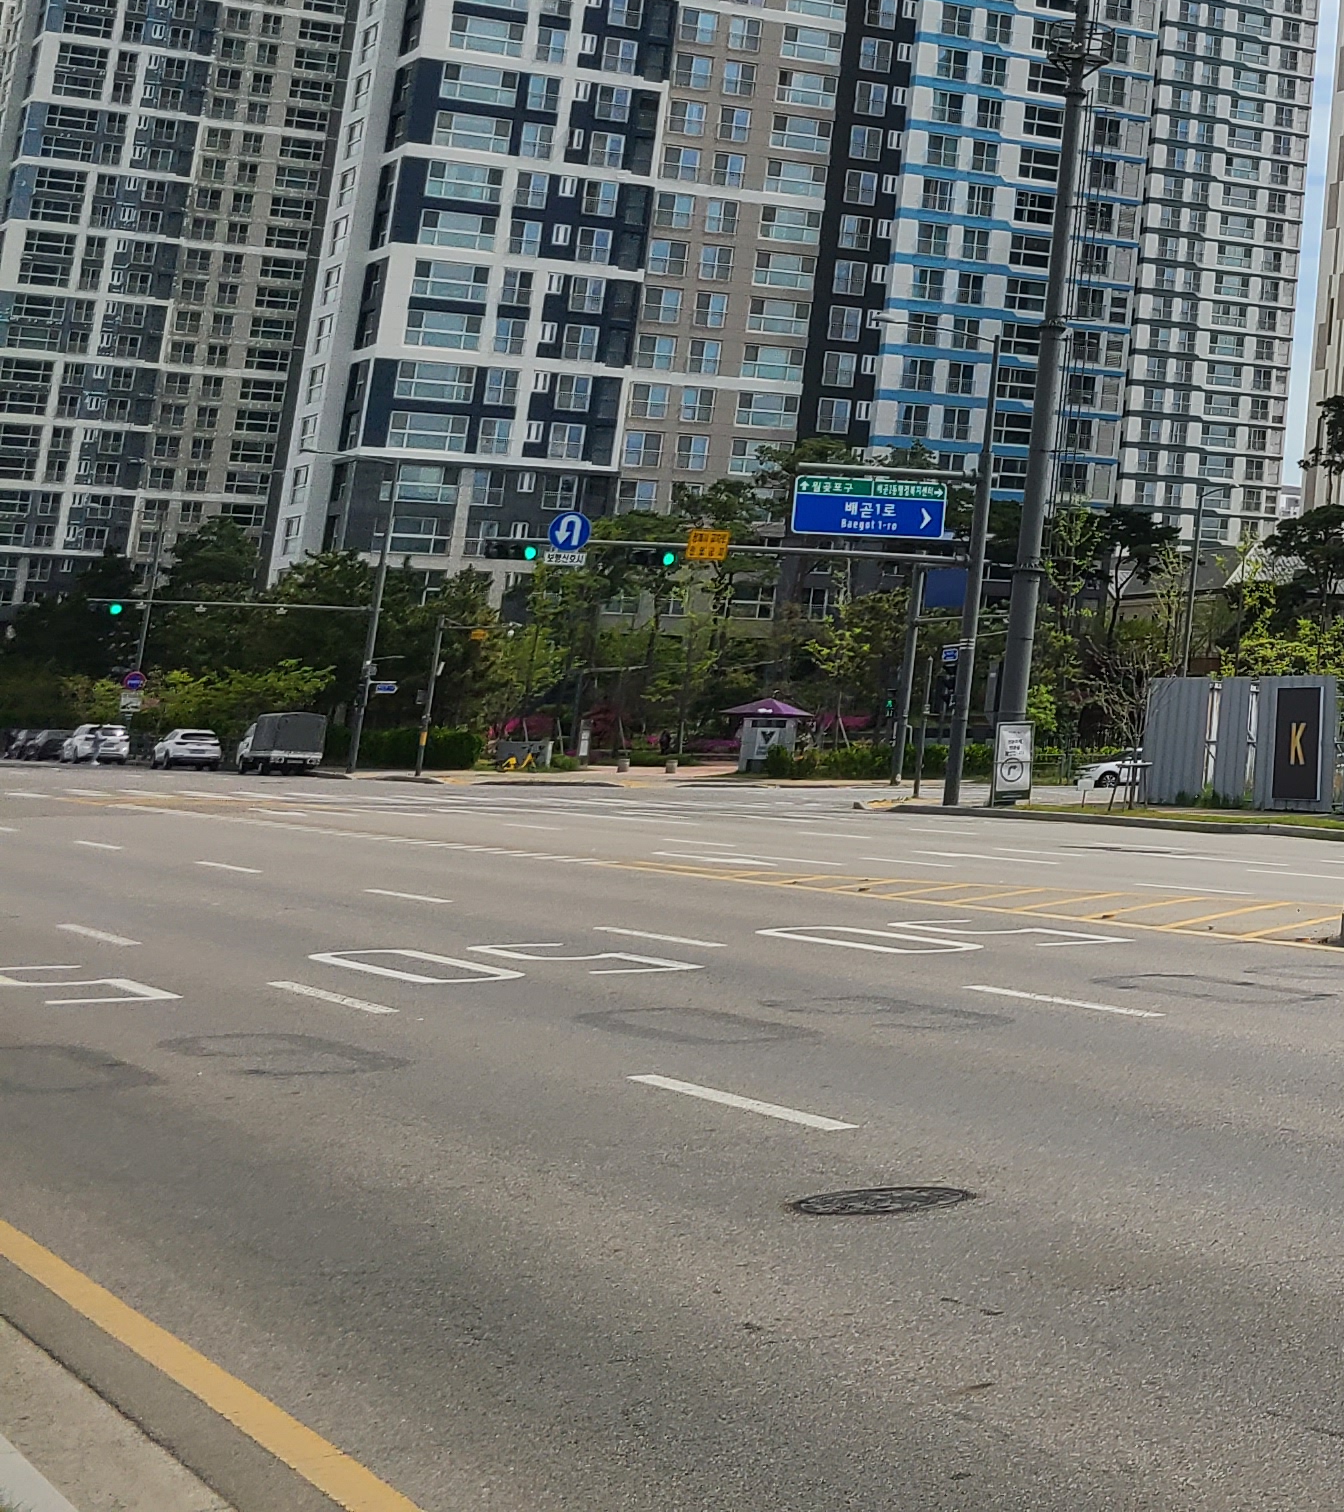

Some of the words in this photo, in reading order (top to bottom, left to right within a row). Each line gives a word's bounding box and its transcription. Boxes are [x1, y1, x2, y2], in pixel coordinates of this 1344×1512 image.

[811, 481, 855, 493] 월곶포구
[844, 501, 898, 519] 배곧1로
[840, 518, 875, 531] Baegot
[877, 520, 898, 531] 1-ro
[547, 553, 584, 564] 보행신호시
[1289, 722, 1307, 767] K
